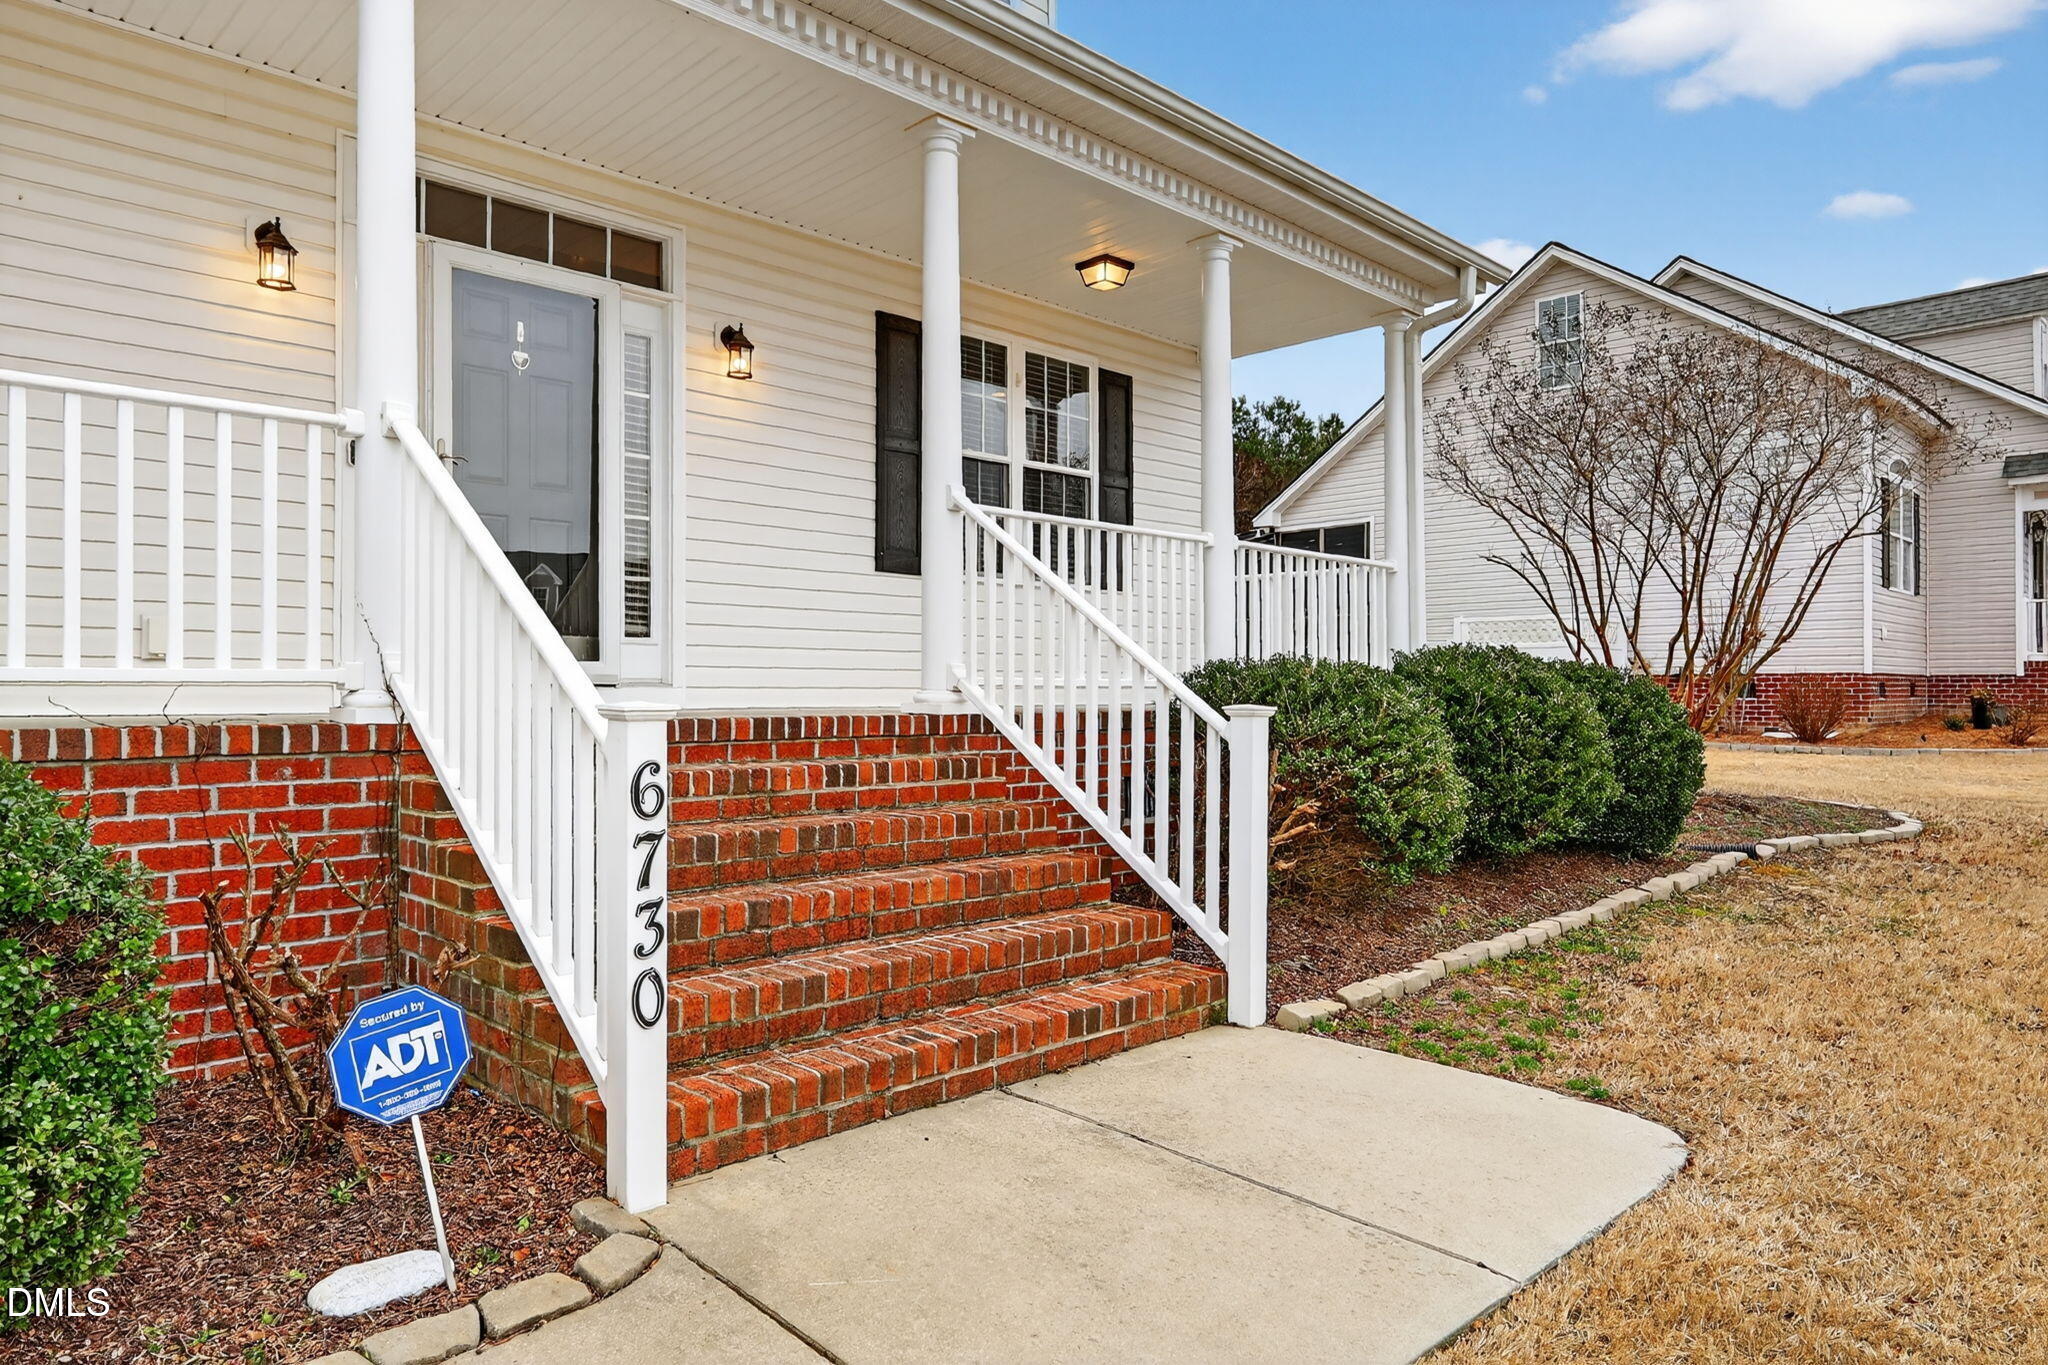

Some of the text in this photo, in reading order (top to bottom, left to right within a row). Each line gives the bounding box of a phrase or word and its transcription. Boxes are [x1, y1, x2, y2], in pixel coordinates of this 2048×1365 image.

[630, 759, 666, 1029] 6730
[359, 1001, 425, 1028] Secured by
[361, 1020, 443, 1090] ADT
